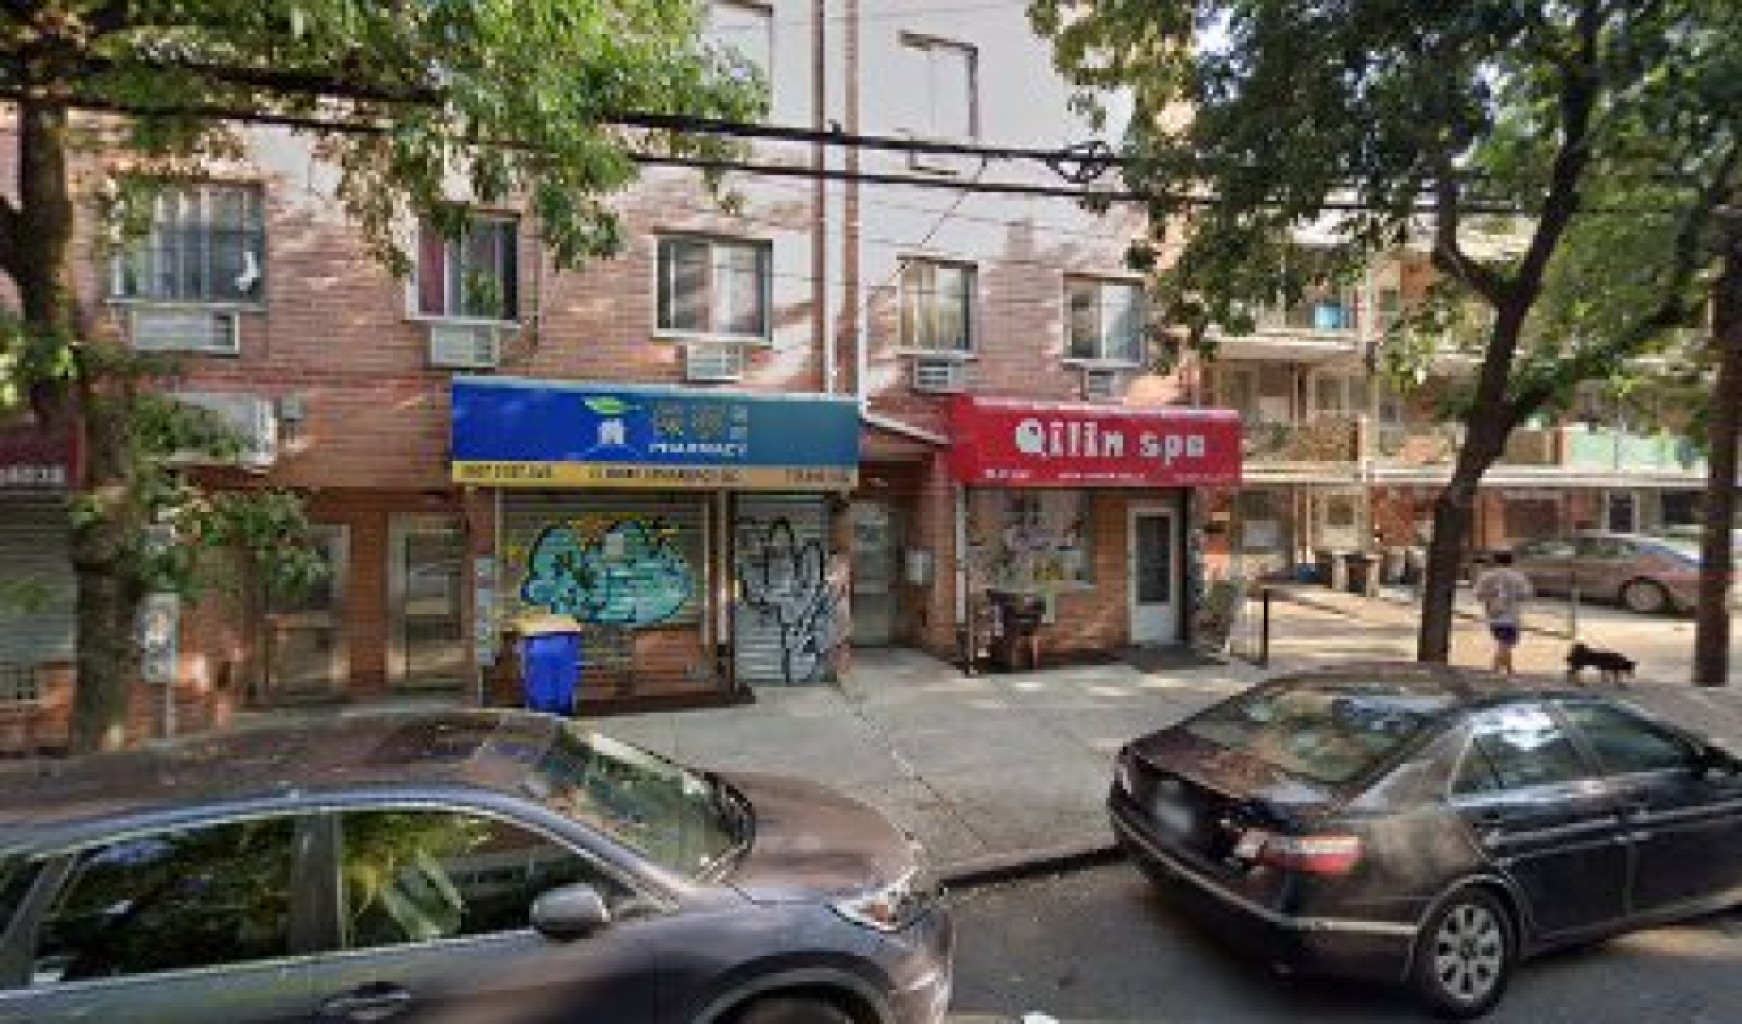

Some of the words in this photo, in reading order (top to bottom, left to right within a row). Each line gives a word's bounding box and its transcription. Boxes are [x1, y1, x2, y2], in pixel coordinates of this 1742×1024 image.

[647, 442, 747, 457] PHARMACY
[1015, 417, 1124, 459] Qilin
[1140, 432, 1204, 464] spa
